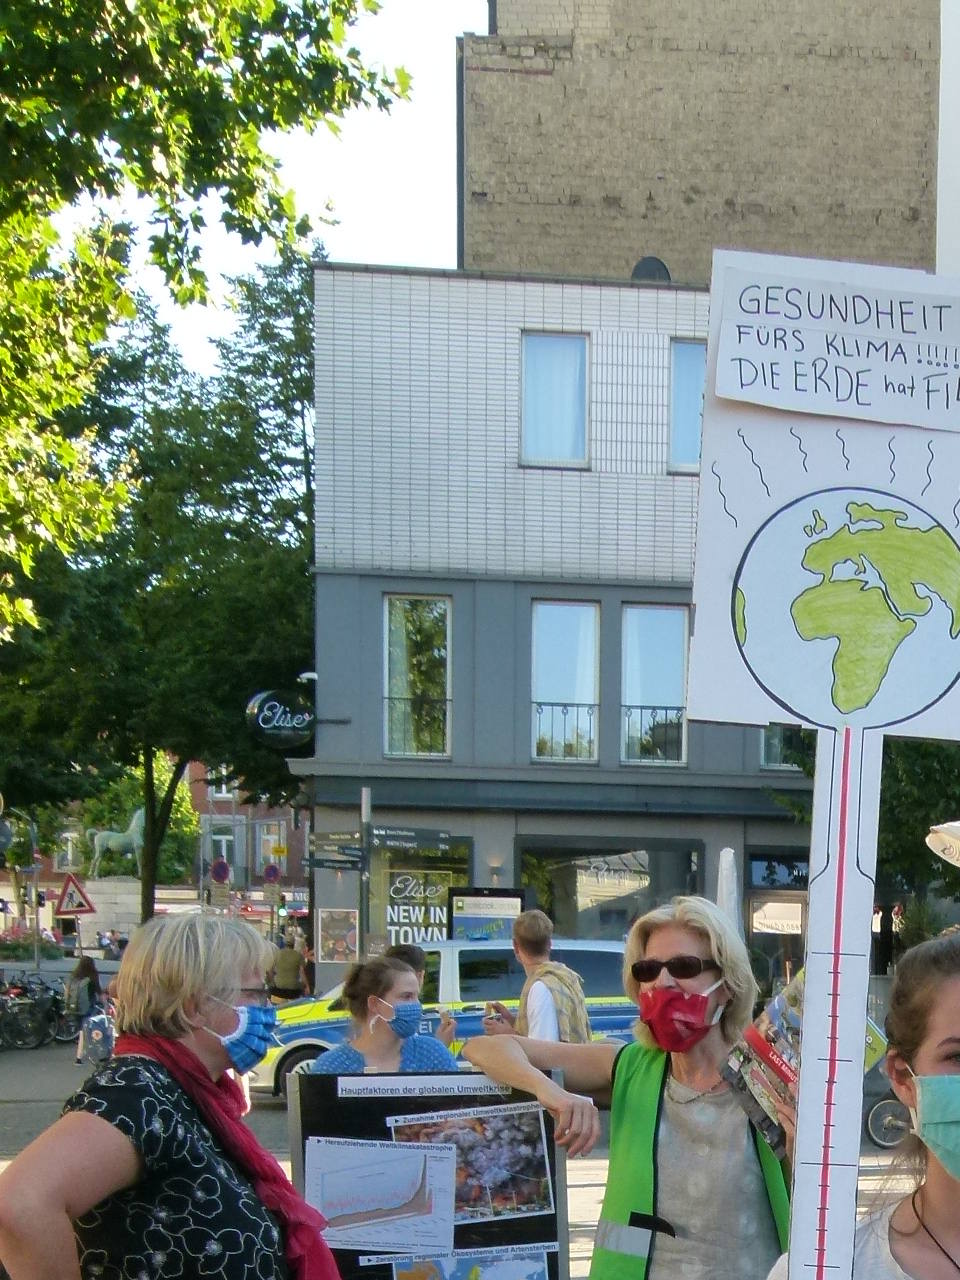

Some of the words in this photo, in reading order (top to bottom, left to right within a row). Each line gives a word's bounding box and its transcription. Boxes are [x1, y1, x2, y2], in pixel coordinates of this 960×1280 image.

[738, 284, 952, 335] GESUNDHEIT
[736, 325, 805, 353] FÜRS
[731, 358, 781, 390] DIE
[794, 357, 872, 407] ERDE
[884, 374, 917, 398] hat
[259, 701, 314, 728] Elise
[390, 875, 447, 898] Elise
[386, 905, 425, 924] NEW
[430, 906, 447, 924] IN
[386, 925, 447, 947] TOWN
[340, 1085, 400, 1096] Hauptfaktoren
[402, 1086, 416, 1094] der
[418, 1085, 455, 1096] globalen
[457, 1084, 511, 1094] Umweltkrise
[402, 1113, 435, 1124] Zunahme
[436, 1109, 471, 1122] regionaler
[324, 1138, 378, 1149] Heraufziehende
[379, 1141, 453, 1153] Weltklimakatastrophe
[451, 1247, 494, 1258] Ökosysteme
[495, 1247, 509, 1255] und
[510, 1243, 556, 1253] Artensterben
